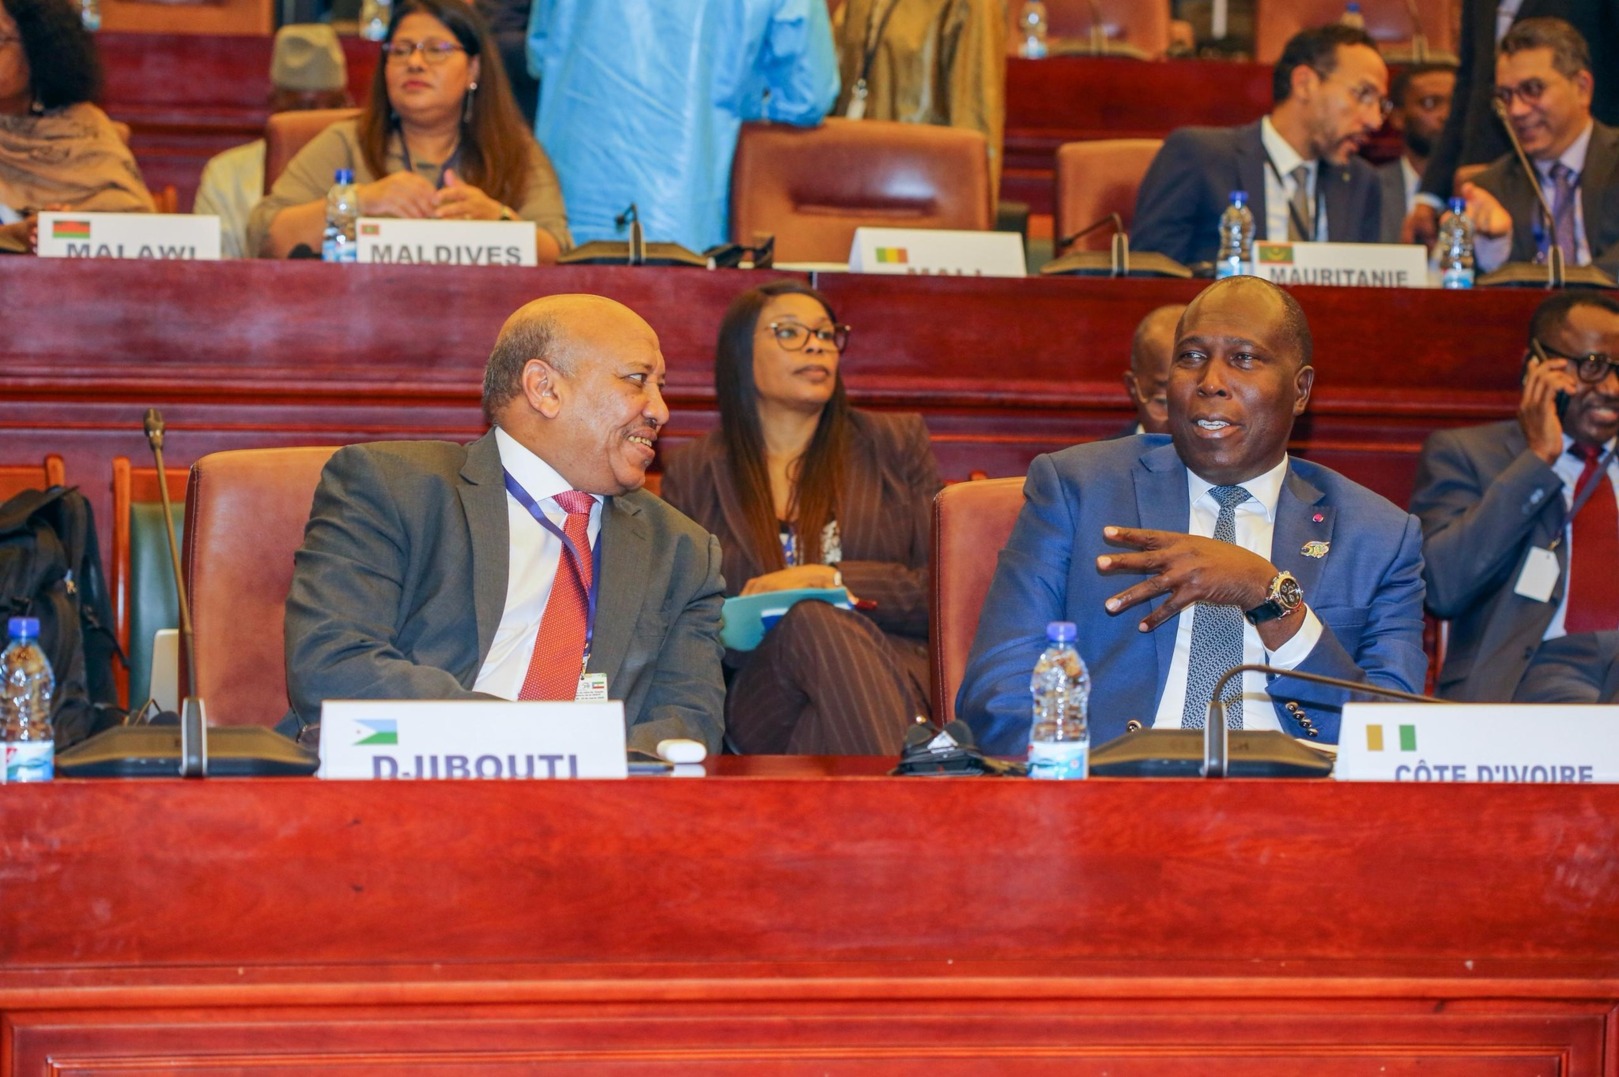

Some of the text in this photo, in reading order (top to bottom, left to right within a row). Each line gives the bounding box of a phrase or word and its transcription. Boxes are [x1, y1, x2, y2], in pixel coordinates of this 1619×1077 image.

[371, 245, 521, 265] MALDIVES
[1270, 267, 1409, 287] MAURITANIE
[373, 754, 579, 779] DJIBOUTI
[1395, 759, 1467, 783] CÔTE
